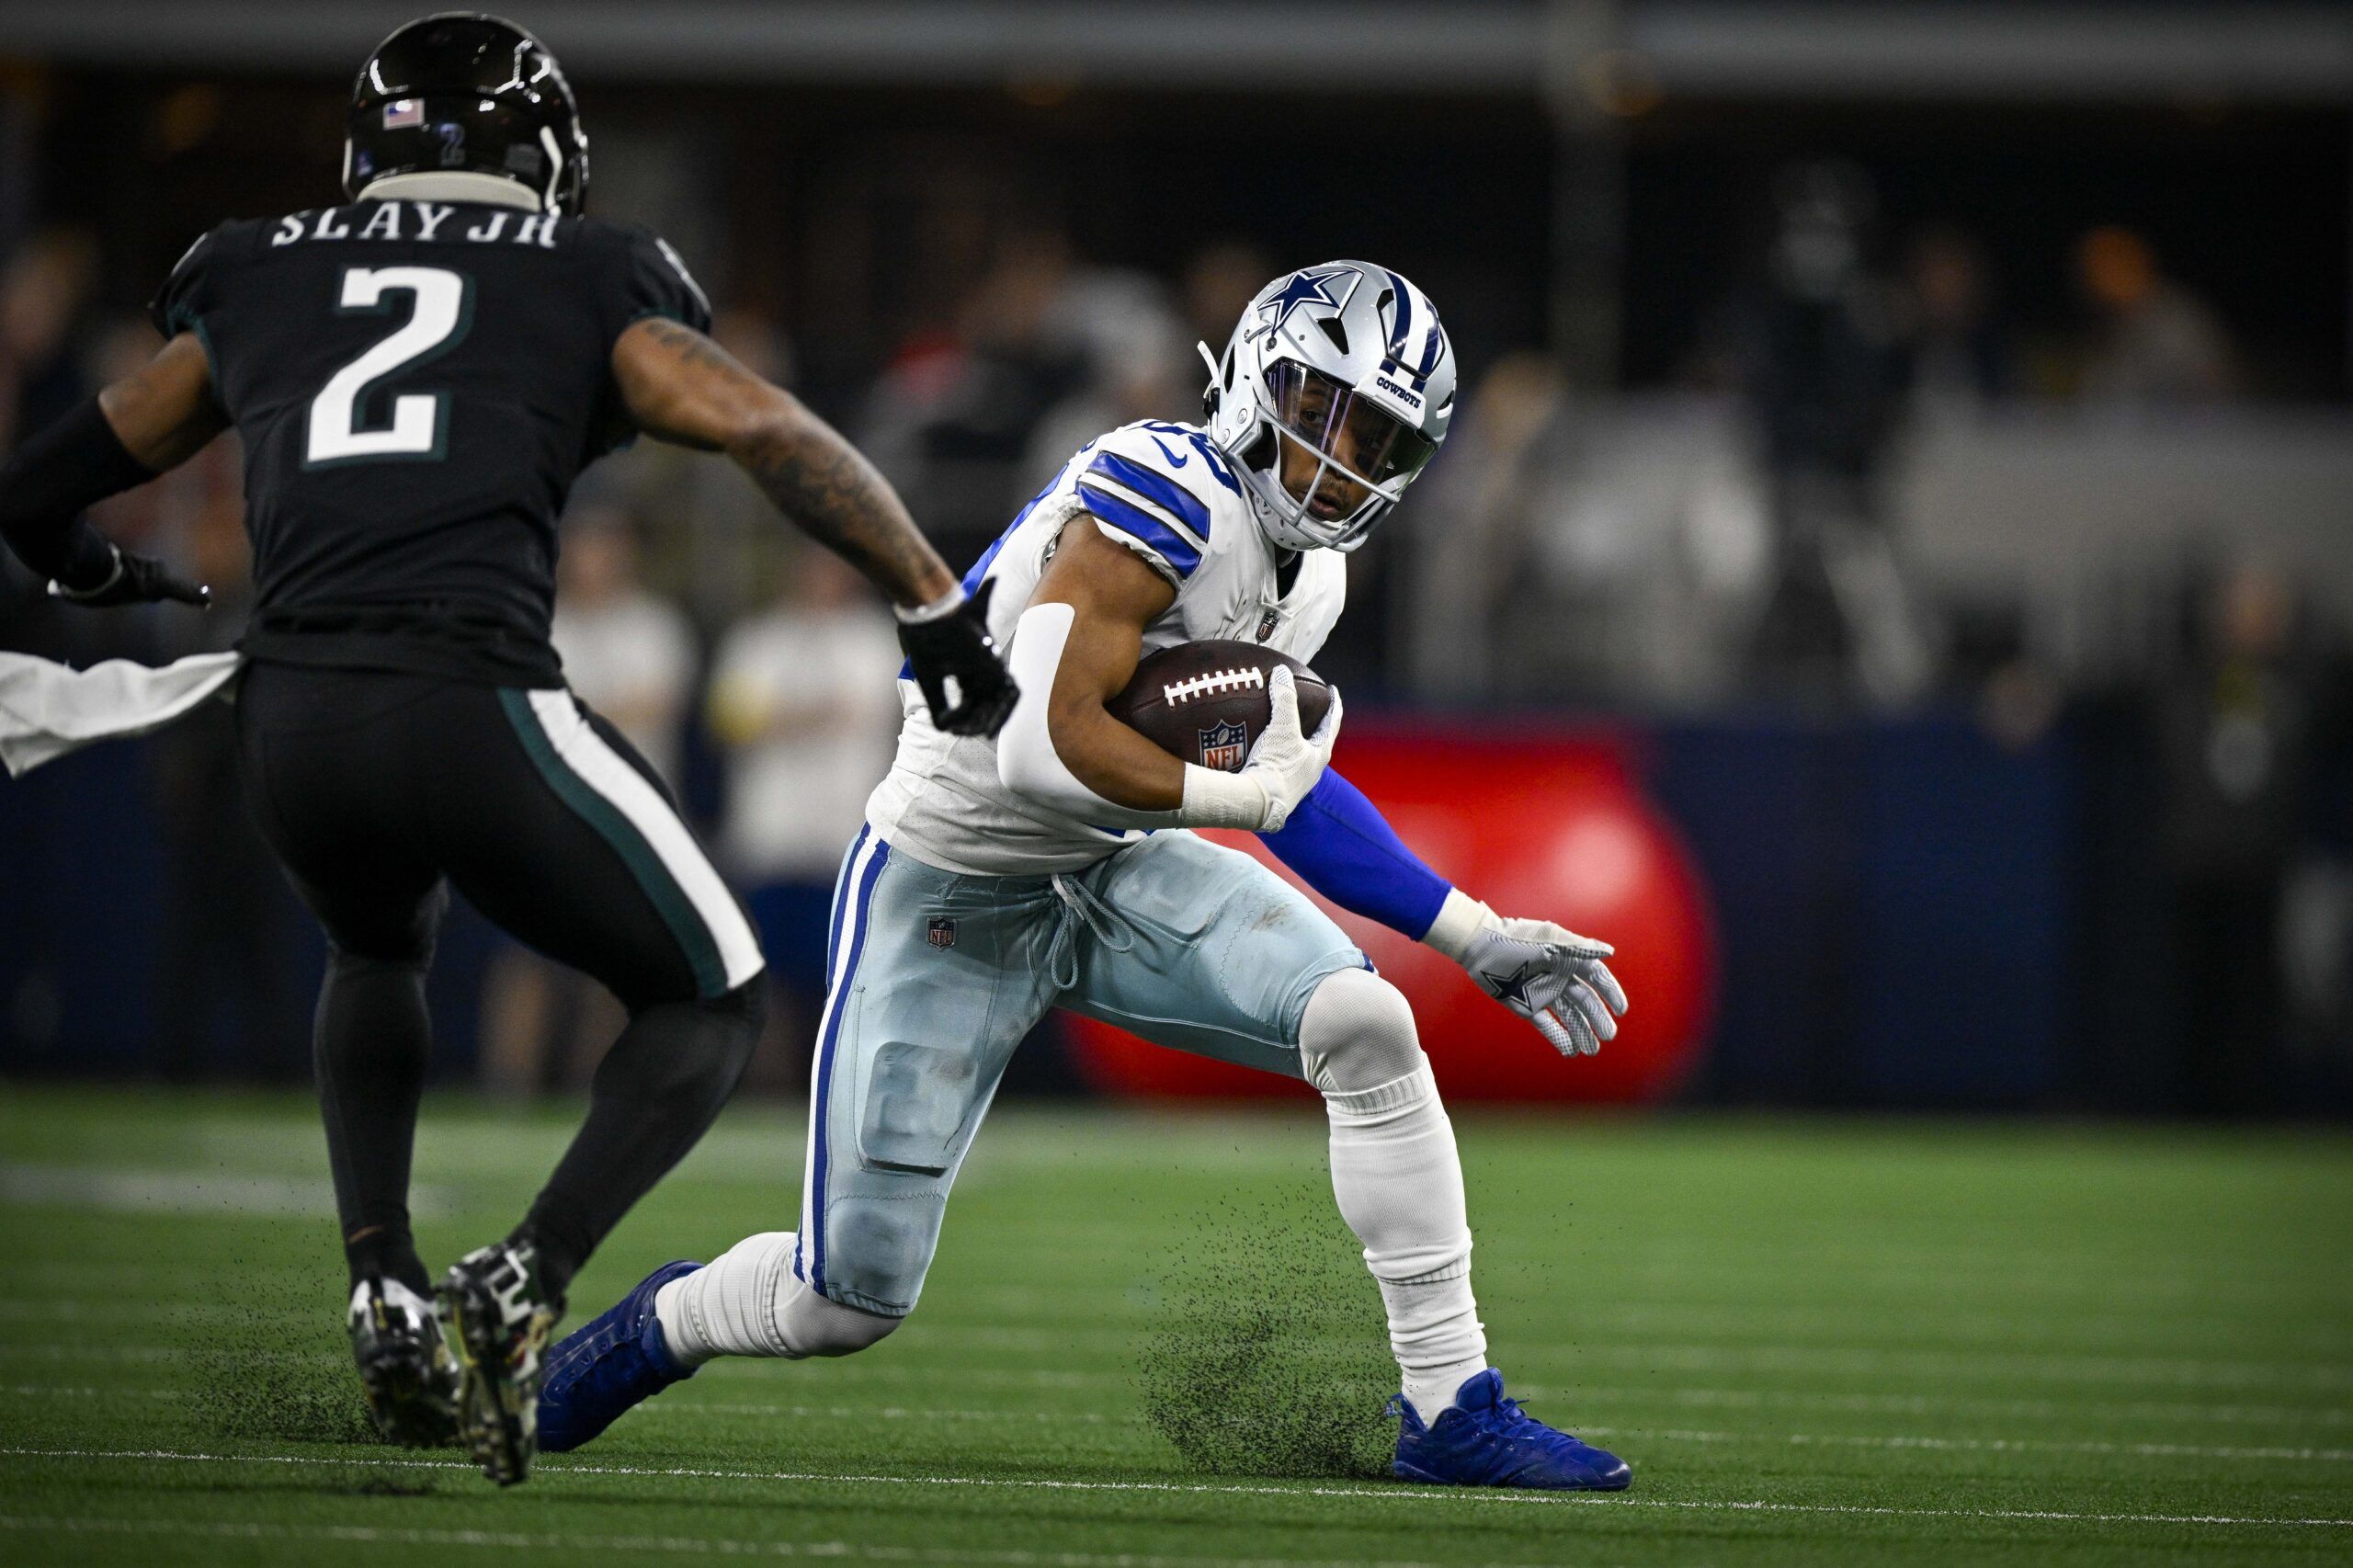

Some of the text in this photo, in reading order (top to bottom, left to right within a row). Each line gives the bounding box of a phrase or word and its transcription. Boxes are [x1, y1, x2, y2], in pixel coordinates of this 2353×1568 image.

[440, 122, 465, 166] 2
[272, 201, 456, 247] SLAY
[306, 265, 464, 463] 2
[1376, 376, 1422, 409] COWBOYS
[1205, 744, 1243, 771] NFL
